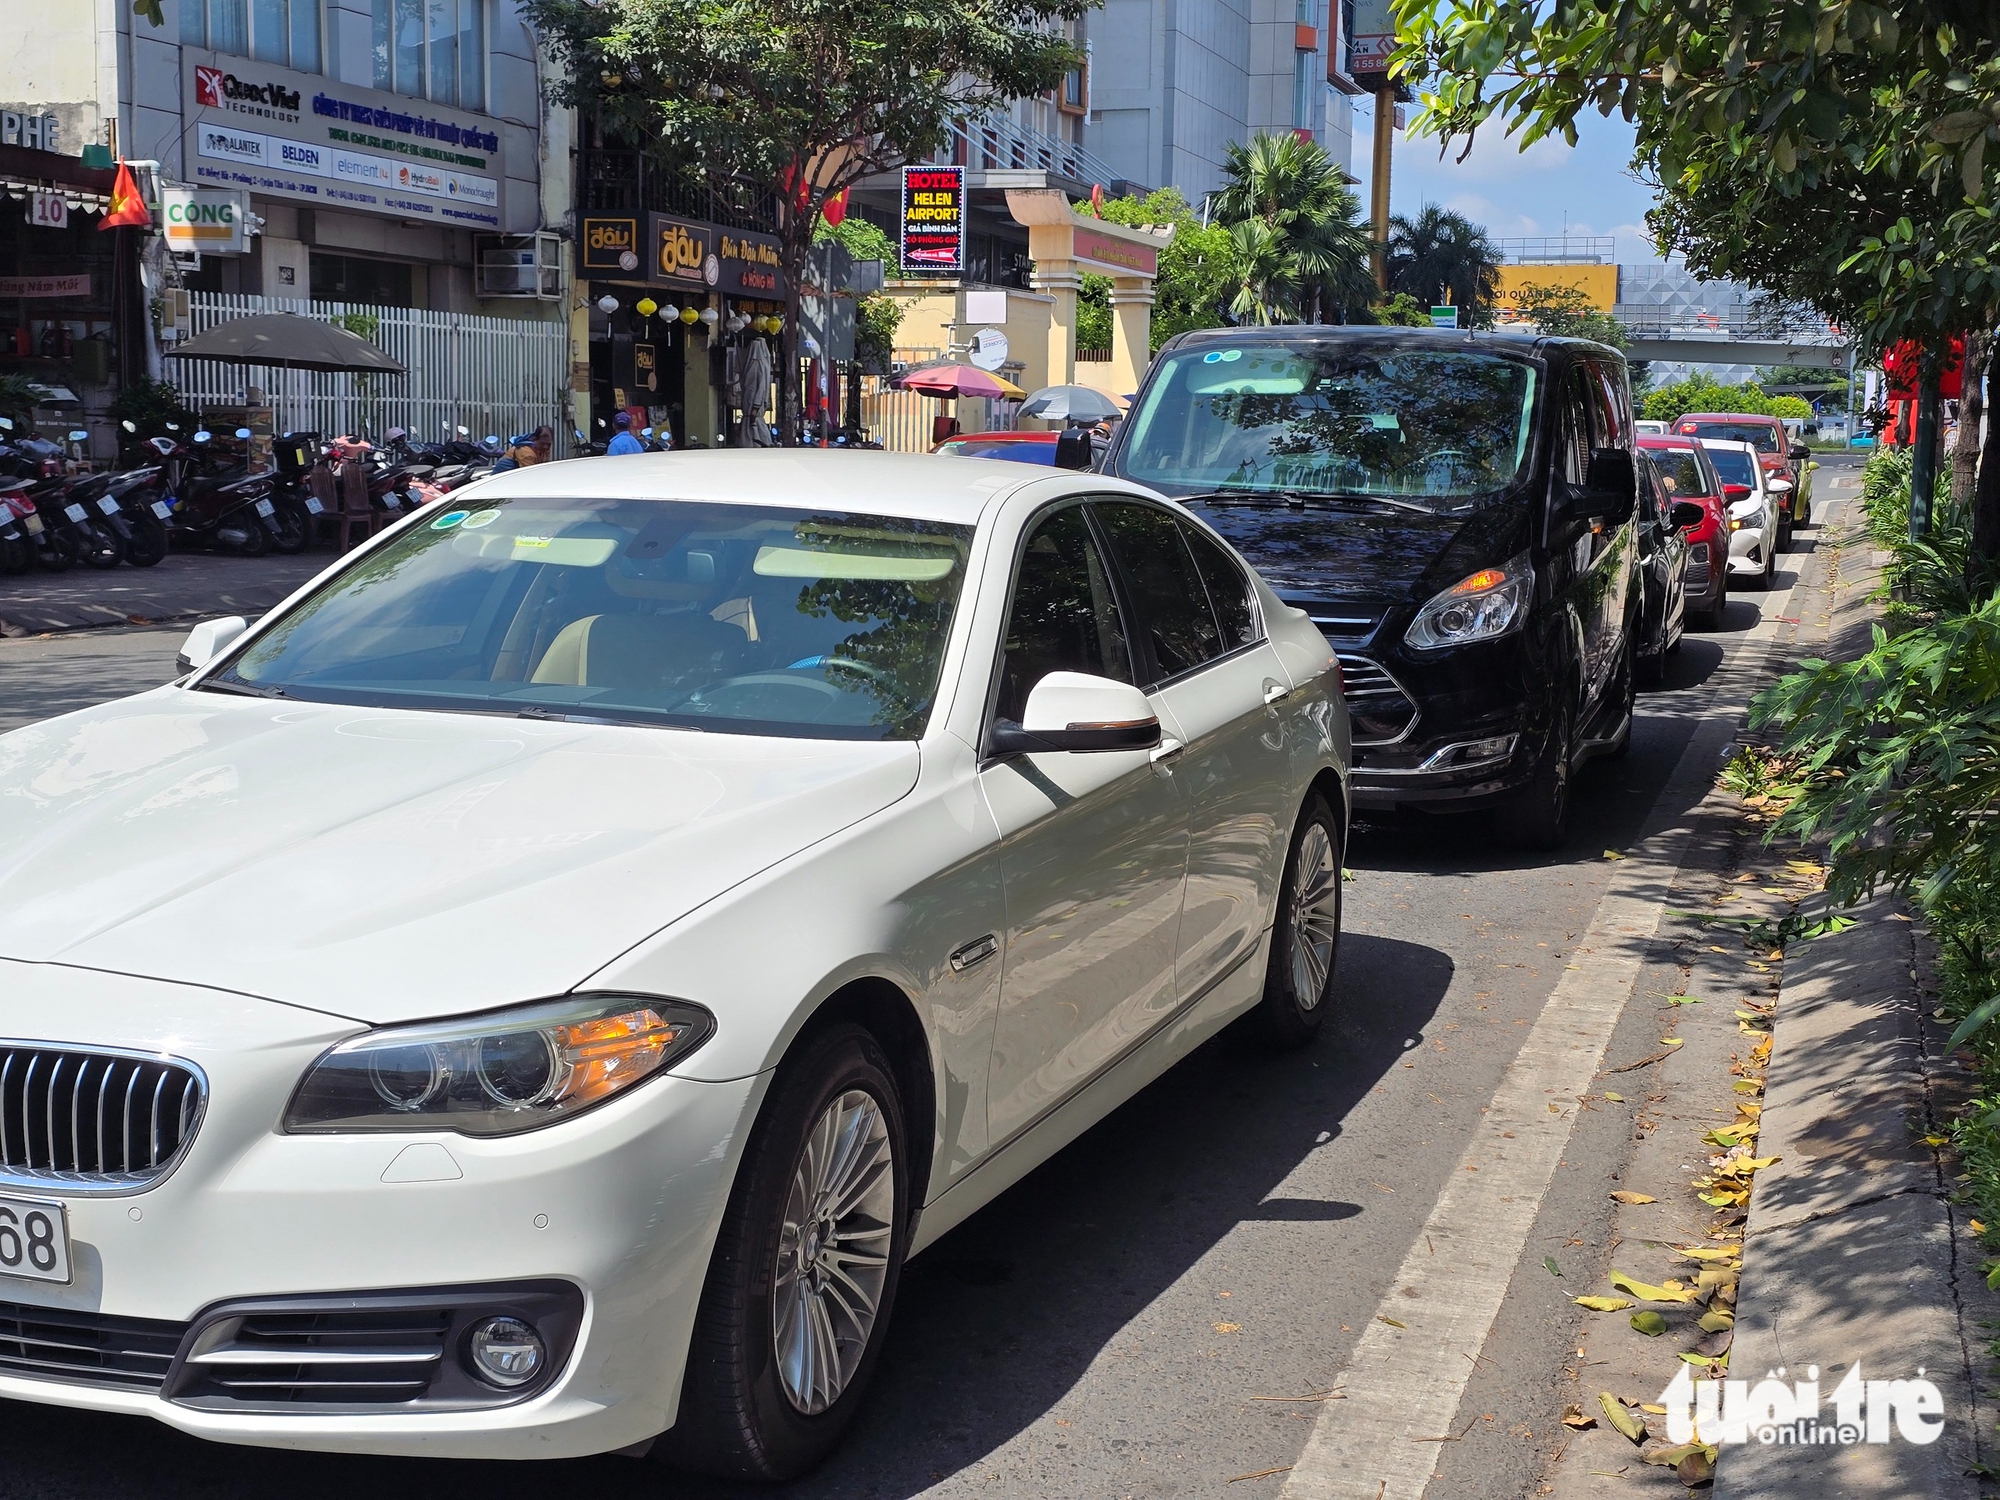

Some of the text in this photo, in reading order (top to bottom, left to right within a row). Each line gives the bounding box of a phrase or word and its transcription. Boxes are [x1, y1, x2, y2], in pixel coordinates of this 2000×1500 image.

[224, 101, 300, 124] TECHNOLOGY
[2, 110, 59, 152] PHÊ
[229, 137, 261, 155] ALANTEK
[282, 144, 319, 165] BELDEN
[907, 173, 959, 188] HOTEL
[459, 184, 495, 202] Monodraught
[914, 192, 952, 205] HELEN
[38, 198, 62, 222] 10
[906, 208, 959, 220] AIRPORT
[940, 222, 957, 233] DÂN
[0, 280, 25, 295] ừng
[742, 271, 748, 286] 6
[0, 1206, 57, 1272] 68
